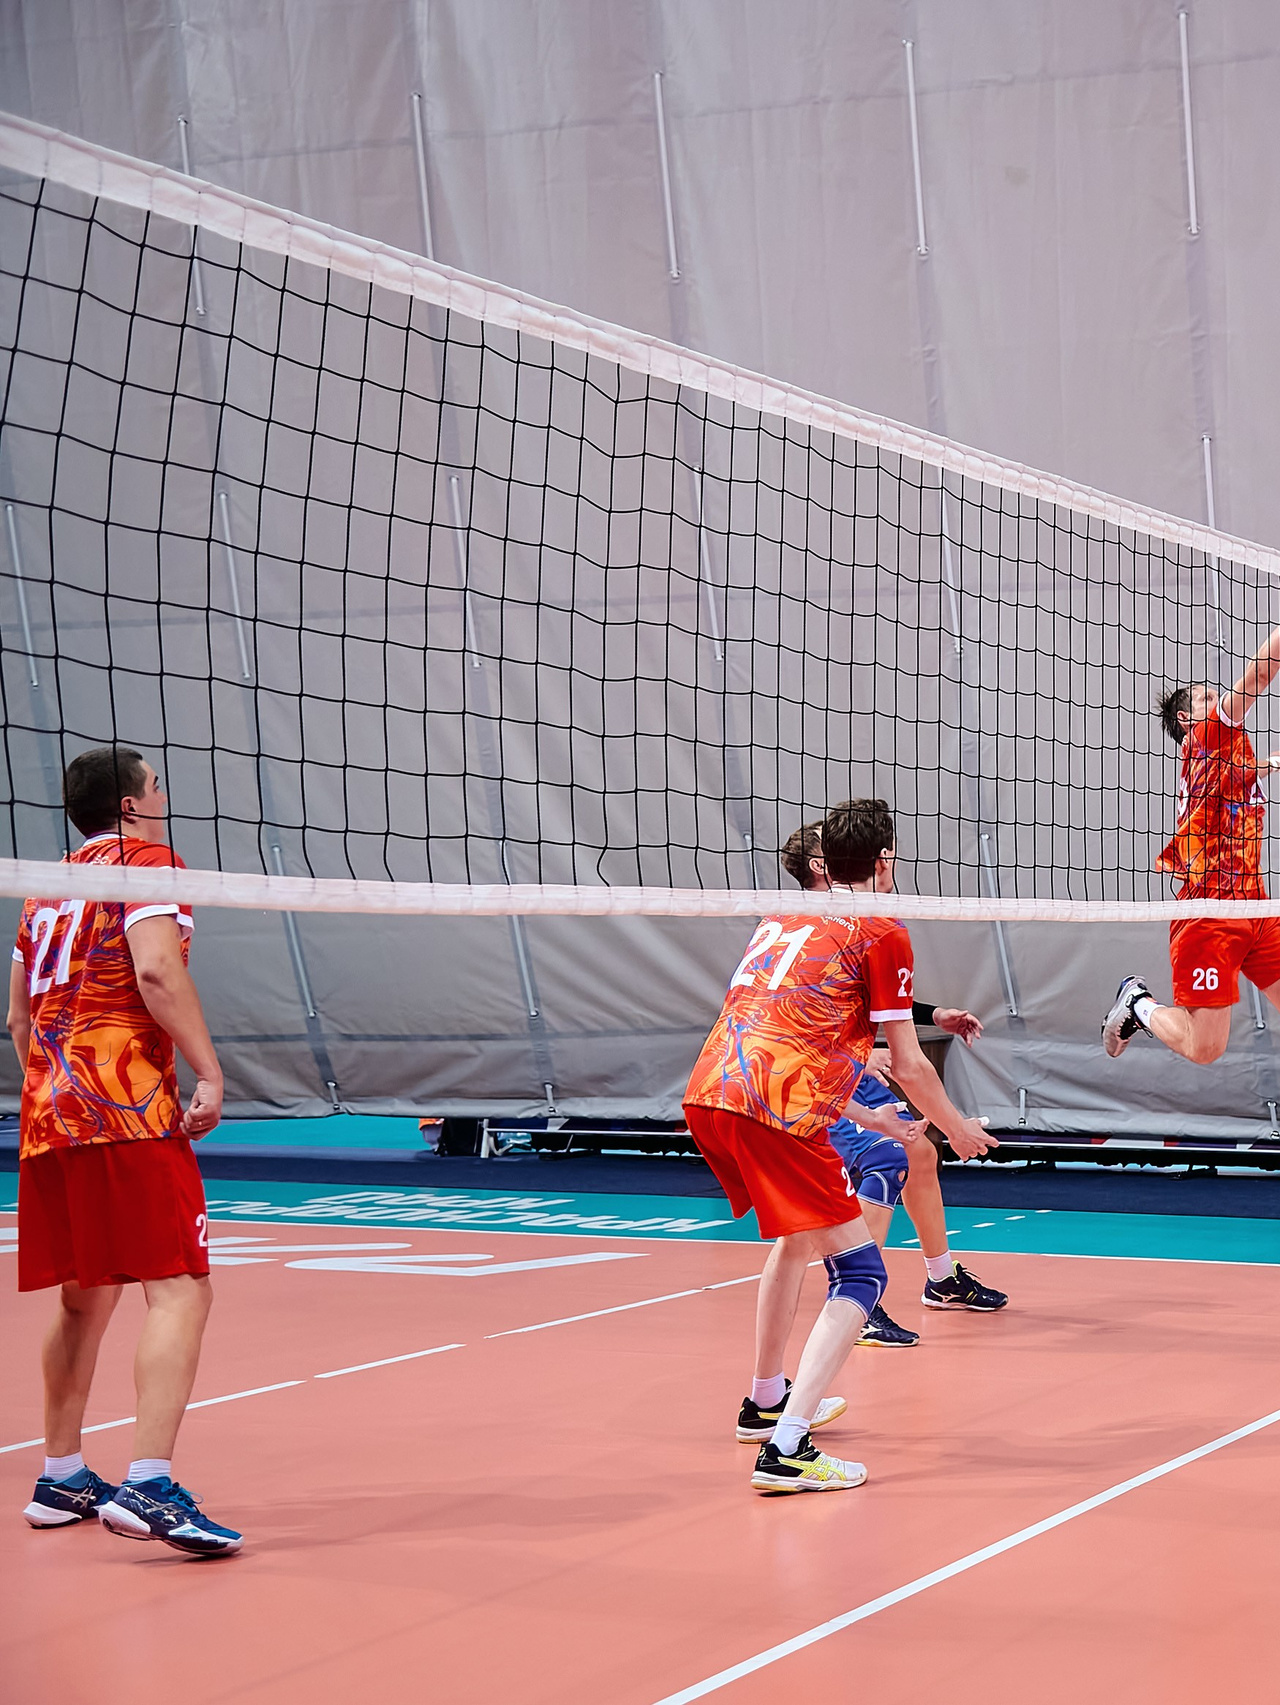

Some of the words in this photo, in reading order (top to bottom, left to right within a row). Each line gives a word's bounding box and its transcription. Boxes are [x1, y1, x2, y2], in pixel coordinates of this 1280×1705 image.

[30, 899, 86, 997] 27
[730, 921, 815, 991] 21
[1192, 967, 1219, 991] 26
[205, 1200, 735, 1232] КРАСНОЯРС
[302, 1191, 575, 1210] КРАЙ
